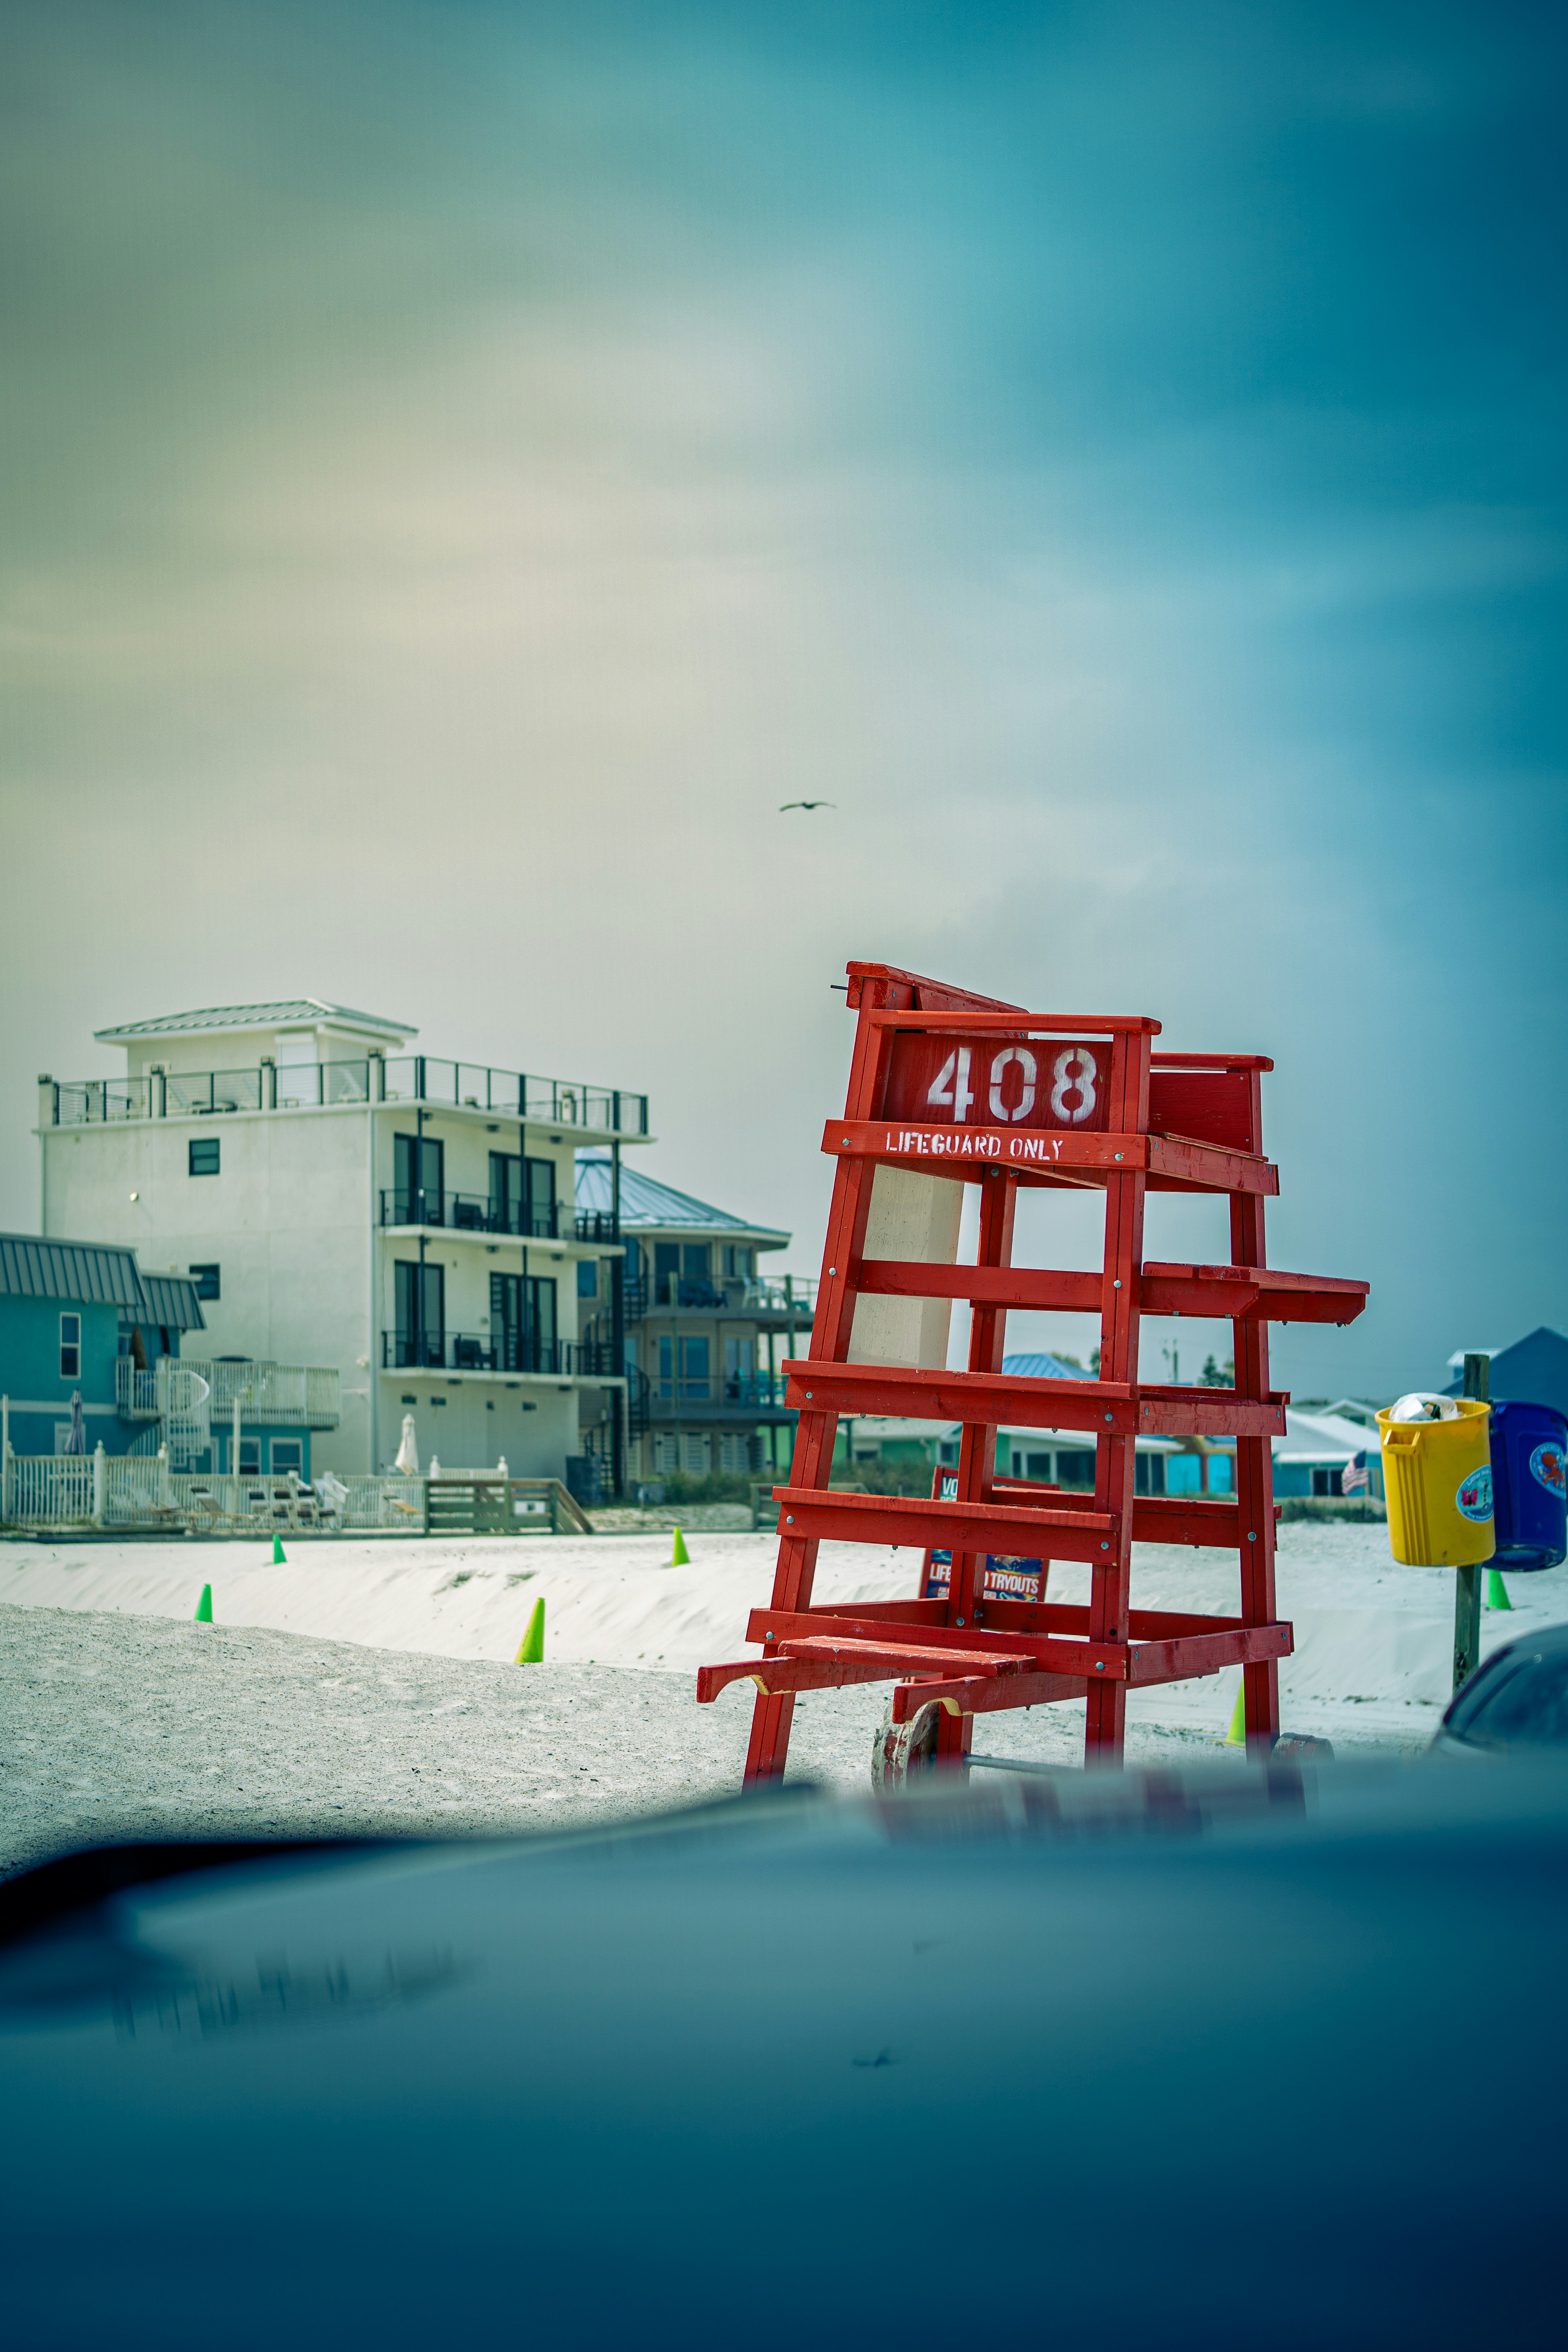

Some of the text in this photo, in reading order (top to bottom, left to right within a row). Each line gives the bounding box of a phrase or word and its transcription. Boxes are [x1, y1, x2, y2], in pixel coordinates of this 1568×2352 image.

[927, 1047, 1097, 1123] 408
[886, 1131, 1064, 1160] LIFEGUARD ONLY
[991, 1572, 1039, 1594] TRYOUTS
